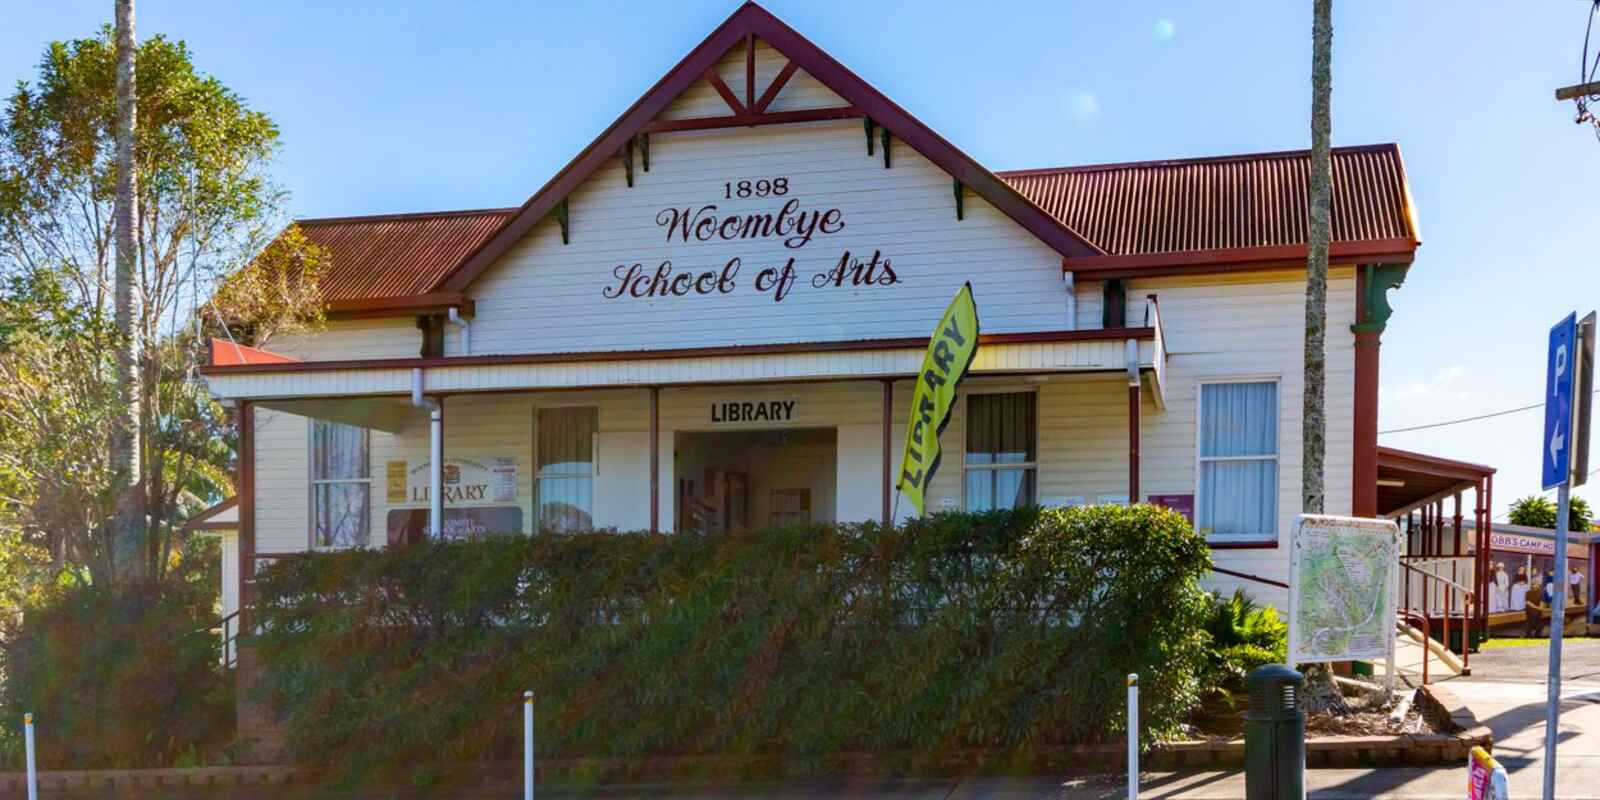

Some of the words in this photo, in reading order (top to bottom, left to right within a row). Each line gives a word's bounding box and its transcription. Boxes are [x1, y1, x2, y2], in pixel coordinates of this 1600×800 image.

[724, 178, 789, 199] 1898
[656, 199, 845, 249] Woombye
[603, 257, 741, 299] School
[755, 257, 798, 301] of
[812, 250, 902, 288] Arts
[1553, 344, 1567, 397] P
[711, 400, 796, 423] LIBRARY
[903, 313, 966, 490] LIBRARY
[412, 484, 488, 503] LIRARY
